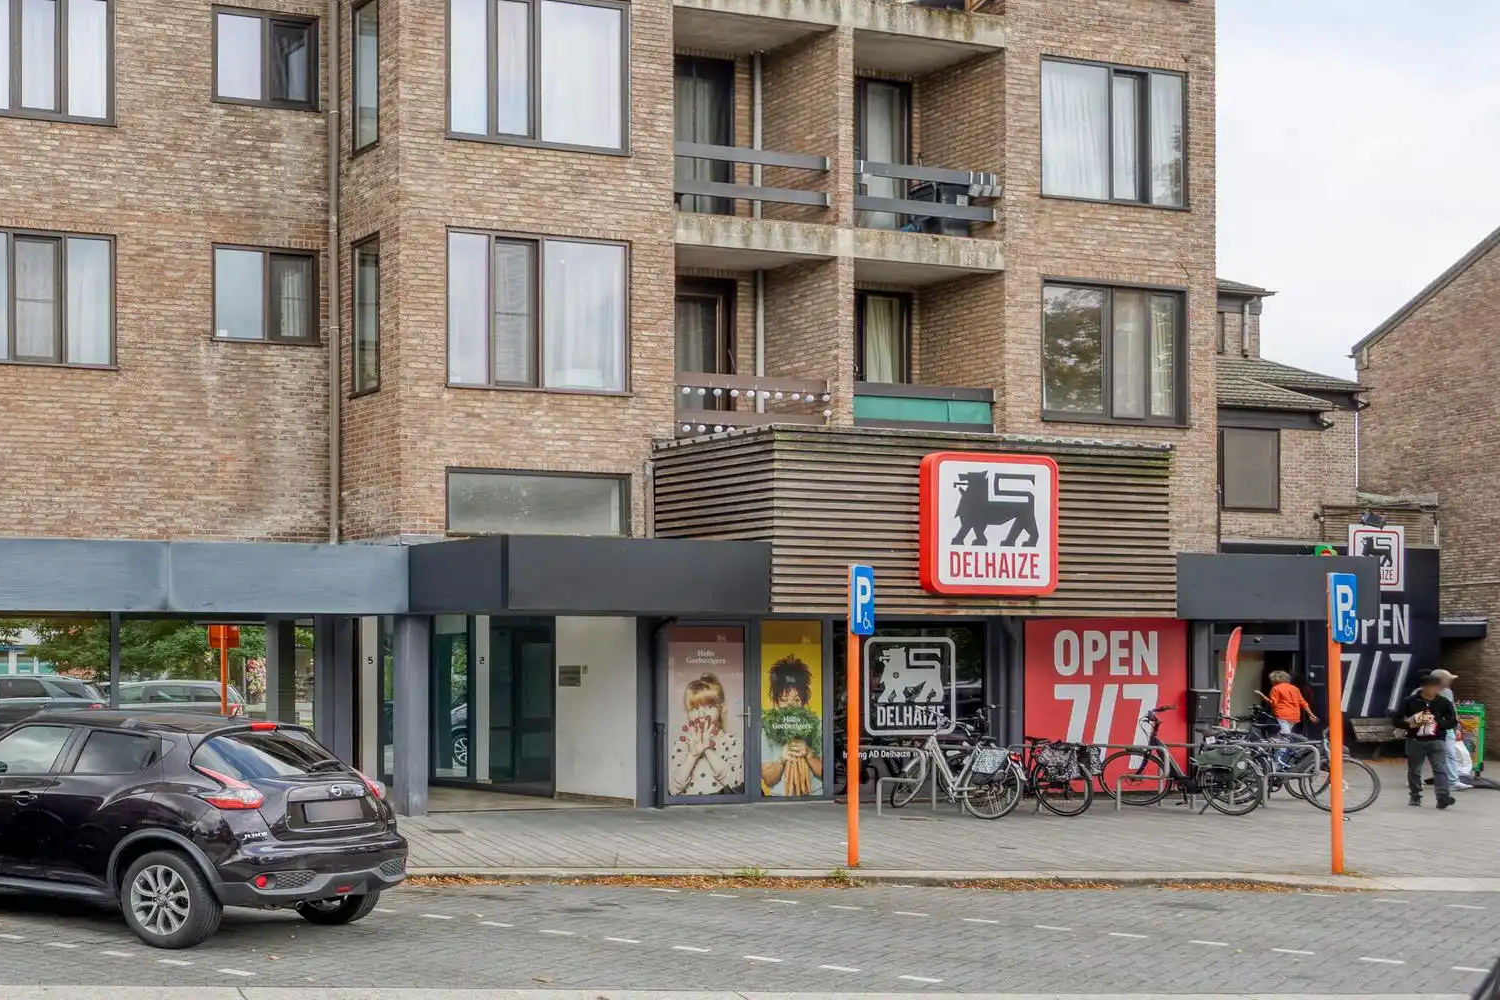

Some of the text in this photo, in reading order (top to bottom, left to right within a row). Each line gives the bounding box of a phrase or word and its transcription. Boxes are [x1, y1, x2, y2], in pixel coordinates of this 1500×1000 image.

[949, 551, 1040, 579] DELHAIZE
[856, 576, 871, 623] P
[1336, 584, 1354, 631] P
[367, 657, 374, 665] 5
[1053, 629, 1158, 676] OPEN
[1340, 651, 1412, 717] 7/7
[876, 705, 945, 726] DELHAIZE
[1054, 683, 1158, 770] 7/7
[868, 750, 880, 758] AD
[881, 750, 911, 758] Delhaize
